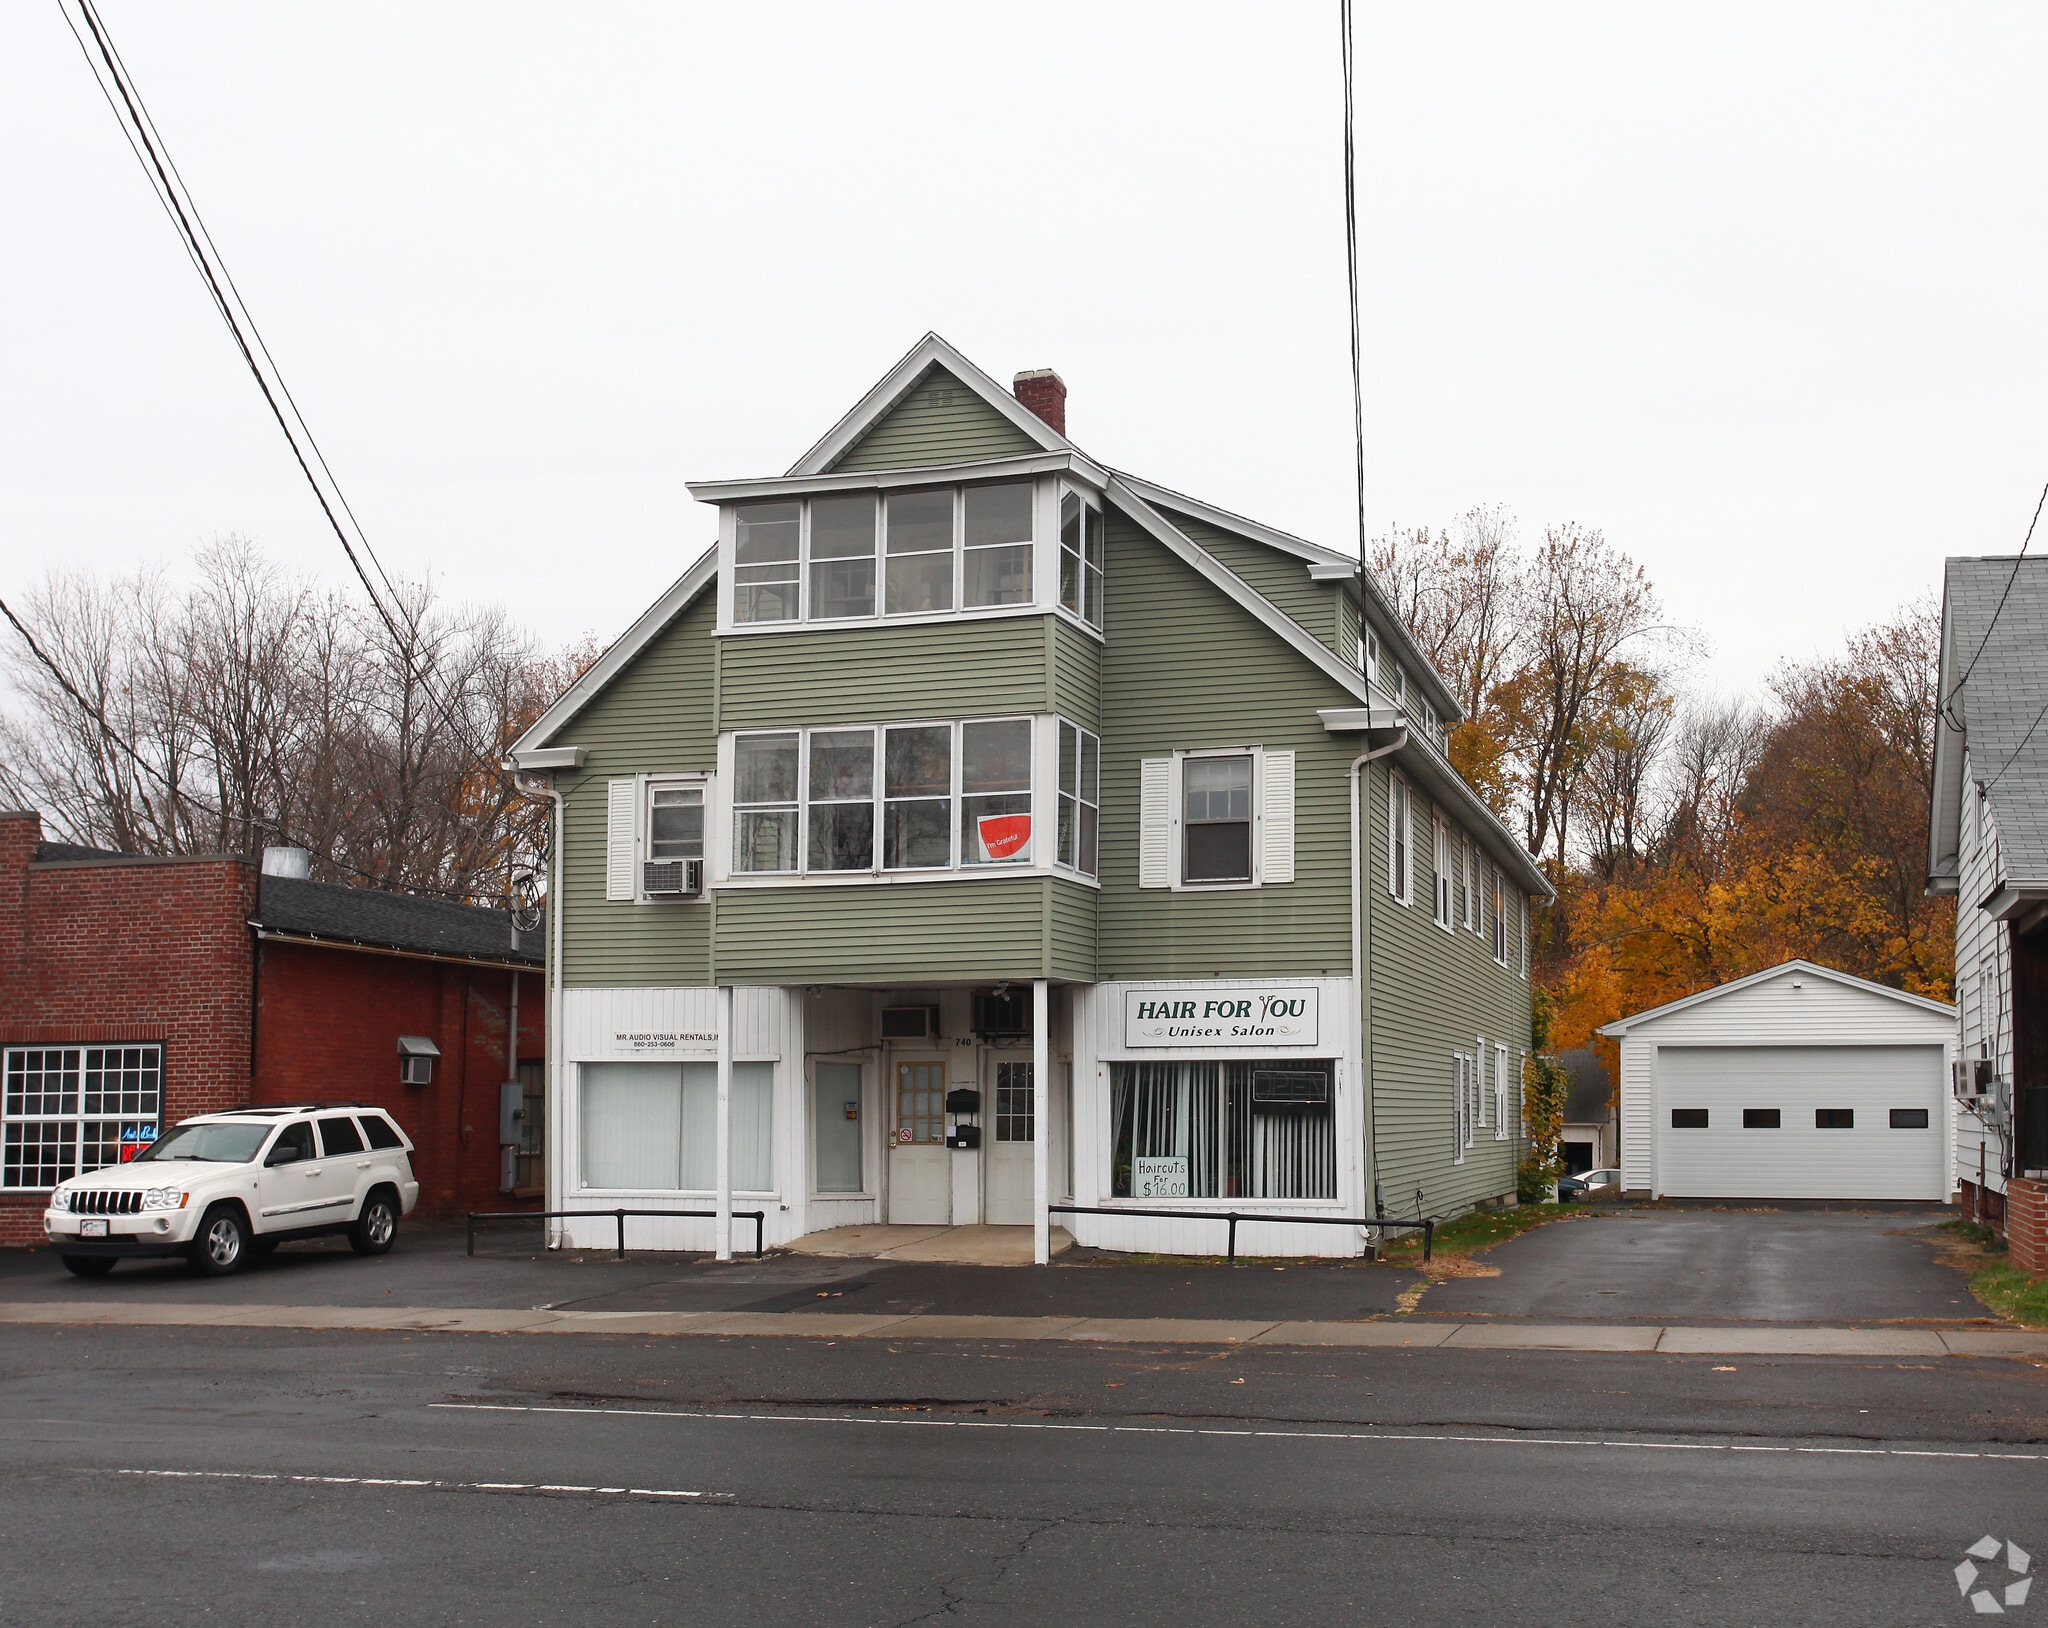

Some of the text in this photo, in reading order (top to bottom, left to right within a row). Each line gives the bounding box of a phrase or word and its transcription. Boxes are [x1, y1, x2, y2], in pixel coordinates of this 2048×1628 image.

[996, 834, 1019, 846] Grateful
[1137, 995, 1306, 1023] HAIR FOR YOU
[1168, 1025, 1276, 1037] Unisex Salon
[955, 1038, 972, 1047] 740
[1255, 1072, 1325, 1100] OPEN
[140, 1125, 158, 1139] Bod
[1139, 1160, 1185, 1174] Haircuts
[1153, 1175, 1168, 1183] For
[1142, 1181, 1186, 1197] $16.00
